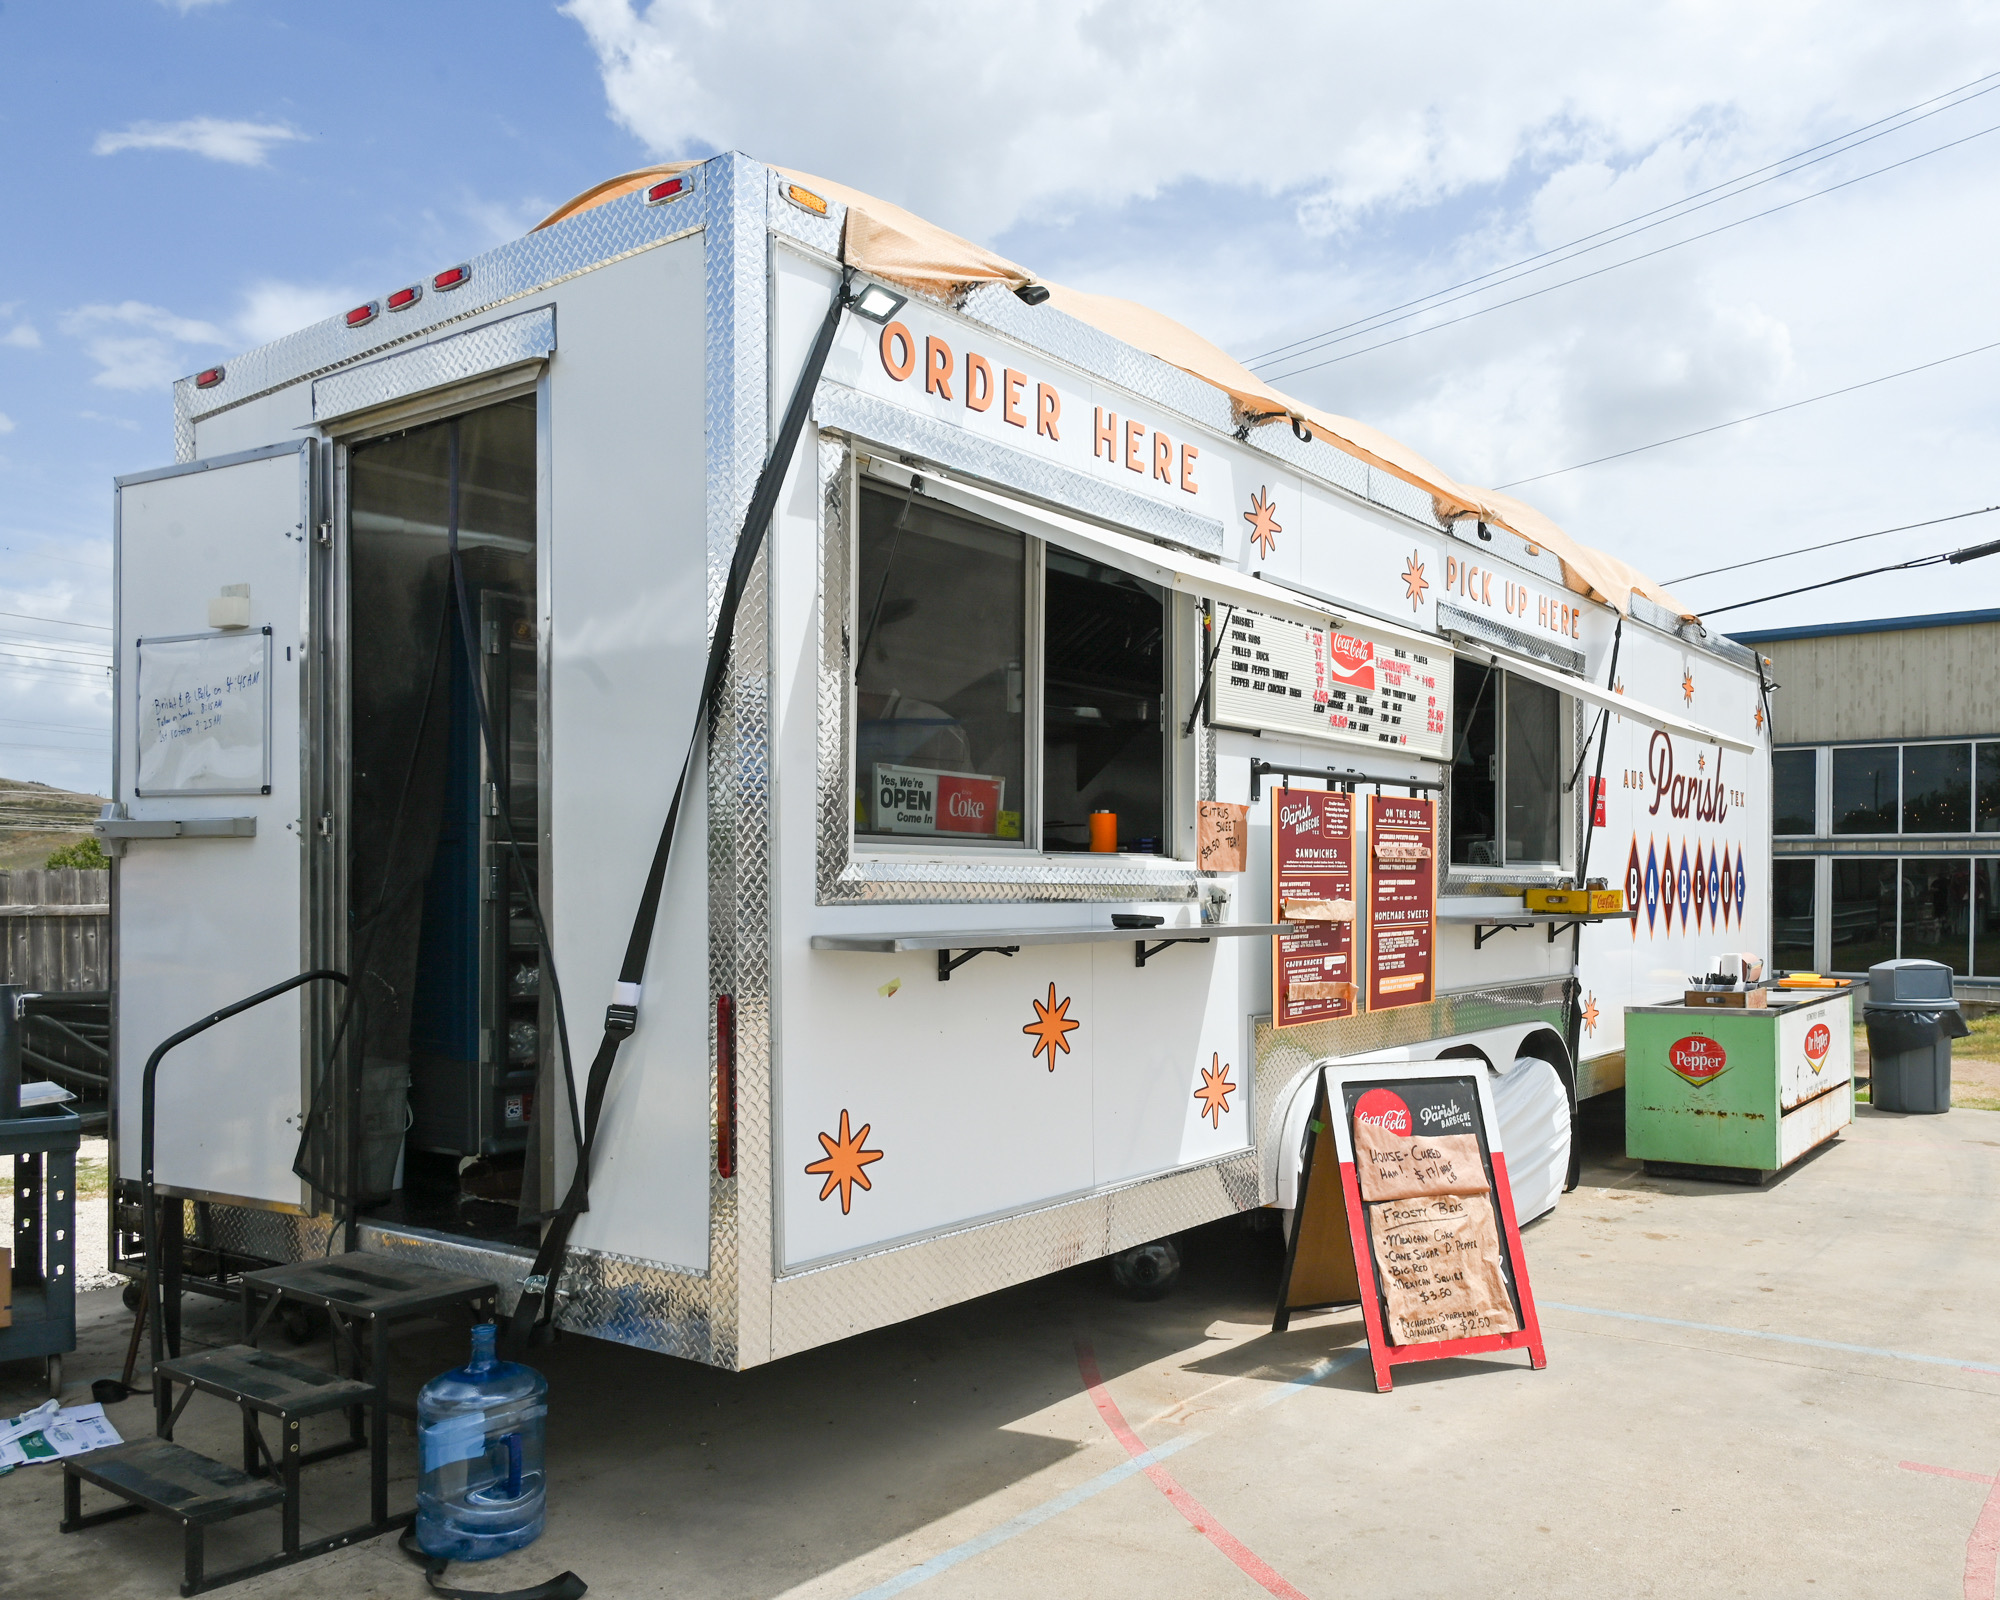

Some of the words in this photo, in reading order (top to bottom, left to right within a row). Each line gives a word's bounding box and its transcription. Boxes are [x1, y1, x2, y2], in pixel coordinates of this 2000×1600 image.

[879, 321, 1061, 441] ORDER
[1094, 406, 1198, 494] HERE
[1447, 555, 1492, 606] PICK
[1506, 580, 1528, 618] UP
[1539, 594, 1580, 639] HERE
[1232, 615, 1254, 628] BRISKET
[1232, 630, 1246, 642] PORK
[1248, 634, 1261, 645] RIBS
[1232, 646, 1251, 658] PULLED
[1256, 651, 1269, 661] DUCK
[1334, 634, 1368, 660] Coca-Cola
[1414, 654, 1427, 665] PLATES
[1232, 661, 1248, 672] LEMON
[1252, 665, 1270, 676] PEPPER
[1272, 669, 1289, 680] TURKEY
[1231, 676, 1249, 687] PEPPER
[1253, 680, 1265, 690] JELLY
[1268, 683, 1286, 695] CHICKEN
[1385, 672, 1402, 686] TRAY
[1333, 690, 1346, 700] HOUSE
[1356, 694, 1367, 704] MADE
[1314, 703, 1325, 713] EACH
[1347, 703, 1353, 711] OR
[1348, 721, 1356, 730] PER
[1359, 723, 1369, 732] LINK
[880, 775, 897, 789] Yes,
[900, 776, 923, 788] We're
[1624, 769, 1643, 790] AUS
[1648, 730, 1728, 824] Parish
[880, 788, 932, 811] OPEN
[950, 792, 985, 819] Coke
[1730, 790, 1744, 807] TEX
[897, 812, 921, 824] Come
[924, 814, 933, 824] In
[1200, 806, 1229, 820] CITRUS
[1280, 796, 1312, 830] Parish
[1386, 808, 1393, 817] ON
[1396, 809, 1406, 818] THE
[1409, 810, 1420, 819] SIDE
[1216, 820, 1236, 833] SWEET
[1296, 816, 1320, 835] BARBECUE
[1201, 838, 1220, 860] $3.50
[1225, 835, 1240, 849] TEA!
[1295, 848, 1338, 858] SANDWICHES
[1630, 868, 1742, 905] BARBECUE
[1375, 910, 1405, 921] HOMEMADE
[1408, 910, 1428, 919] SWEETS
[1286, 960, 1302, 968] CAJUN
[1304, 958, 1323, 966] SNACKS
[1690, 1041, 1706, 1052] Dr
[1808, 1036, 1813, 1051] Dr
[1814, 1031, 1828, 1054] Pepper
[1676, 1051, 1722, 1070] Pepper
[1360, 1110, 1406, 1130] Coca-Cola
[1420, 1099, 1460, 1126] Parish
[1441, 1112, 1471, 1128] BARBECUE
[1447, 1175, 1457, 1184] LB
[1383, 1208, 1427, 1223] FROSTY
[1389, 1250, 1411, 1262] CANE
[1415, 1248, 1439, 1260] SUGAR
[1456, 1240, 1478, 1251] PEPPER
[1392, 1265, 1410, 1276] BIG
[1412, 1263, 1428, 1273] RED
[1396, 1278, 1431, 1290] MEXICAN
[1420, 1288, 1452, 1305] $3.50
[1439, 1309, 1479, 1321] SPARKLING
[1403, 1324, 1448, 1339] RAINWATER
[1460, 1317, 1490, 1335] $2.50
